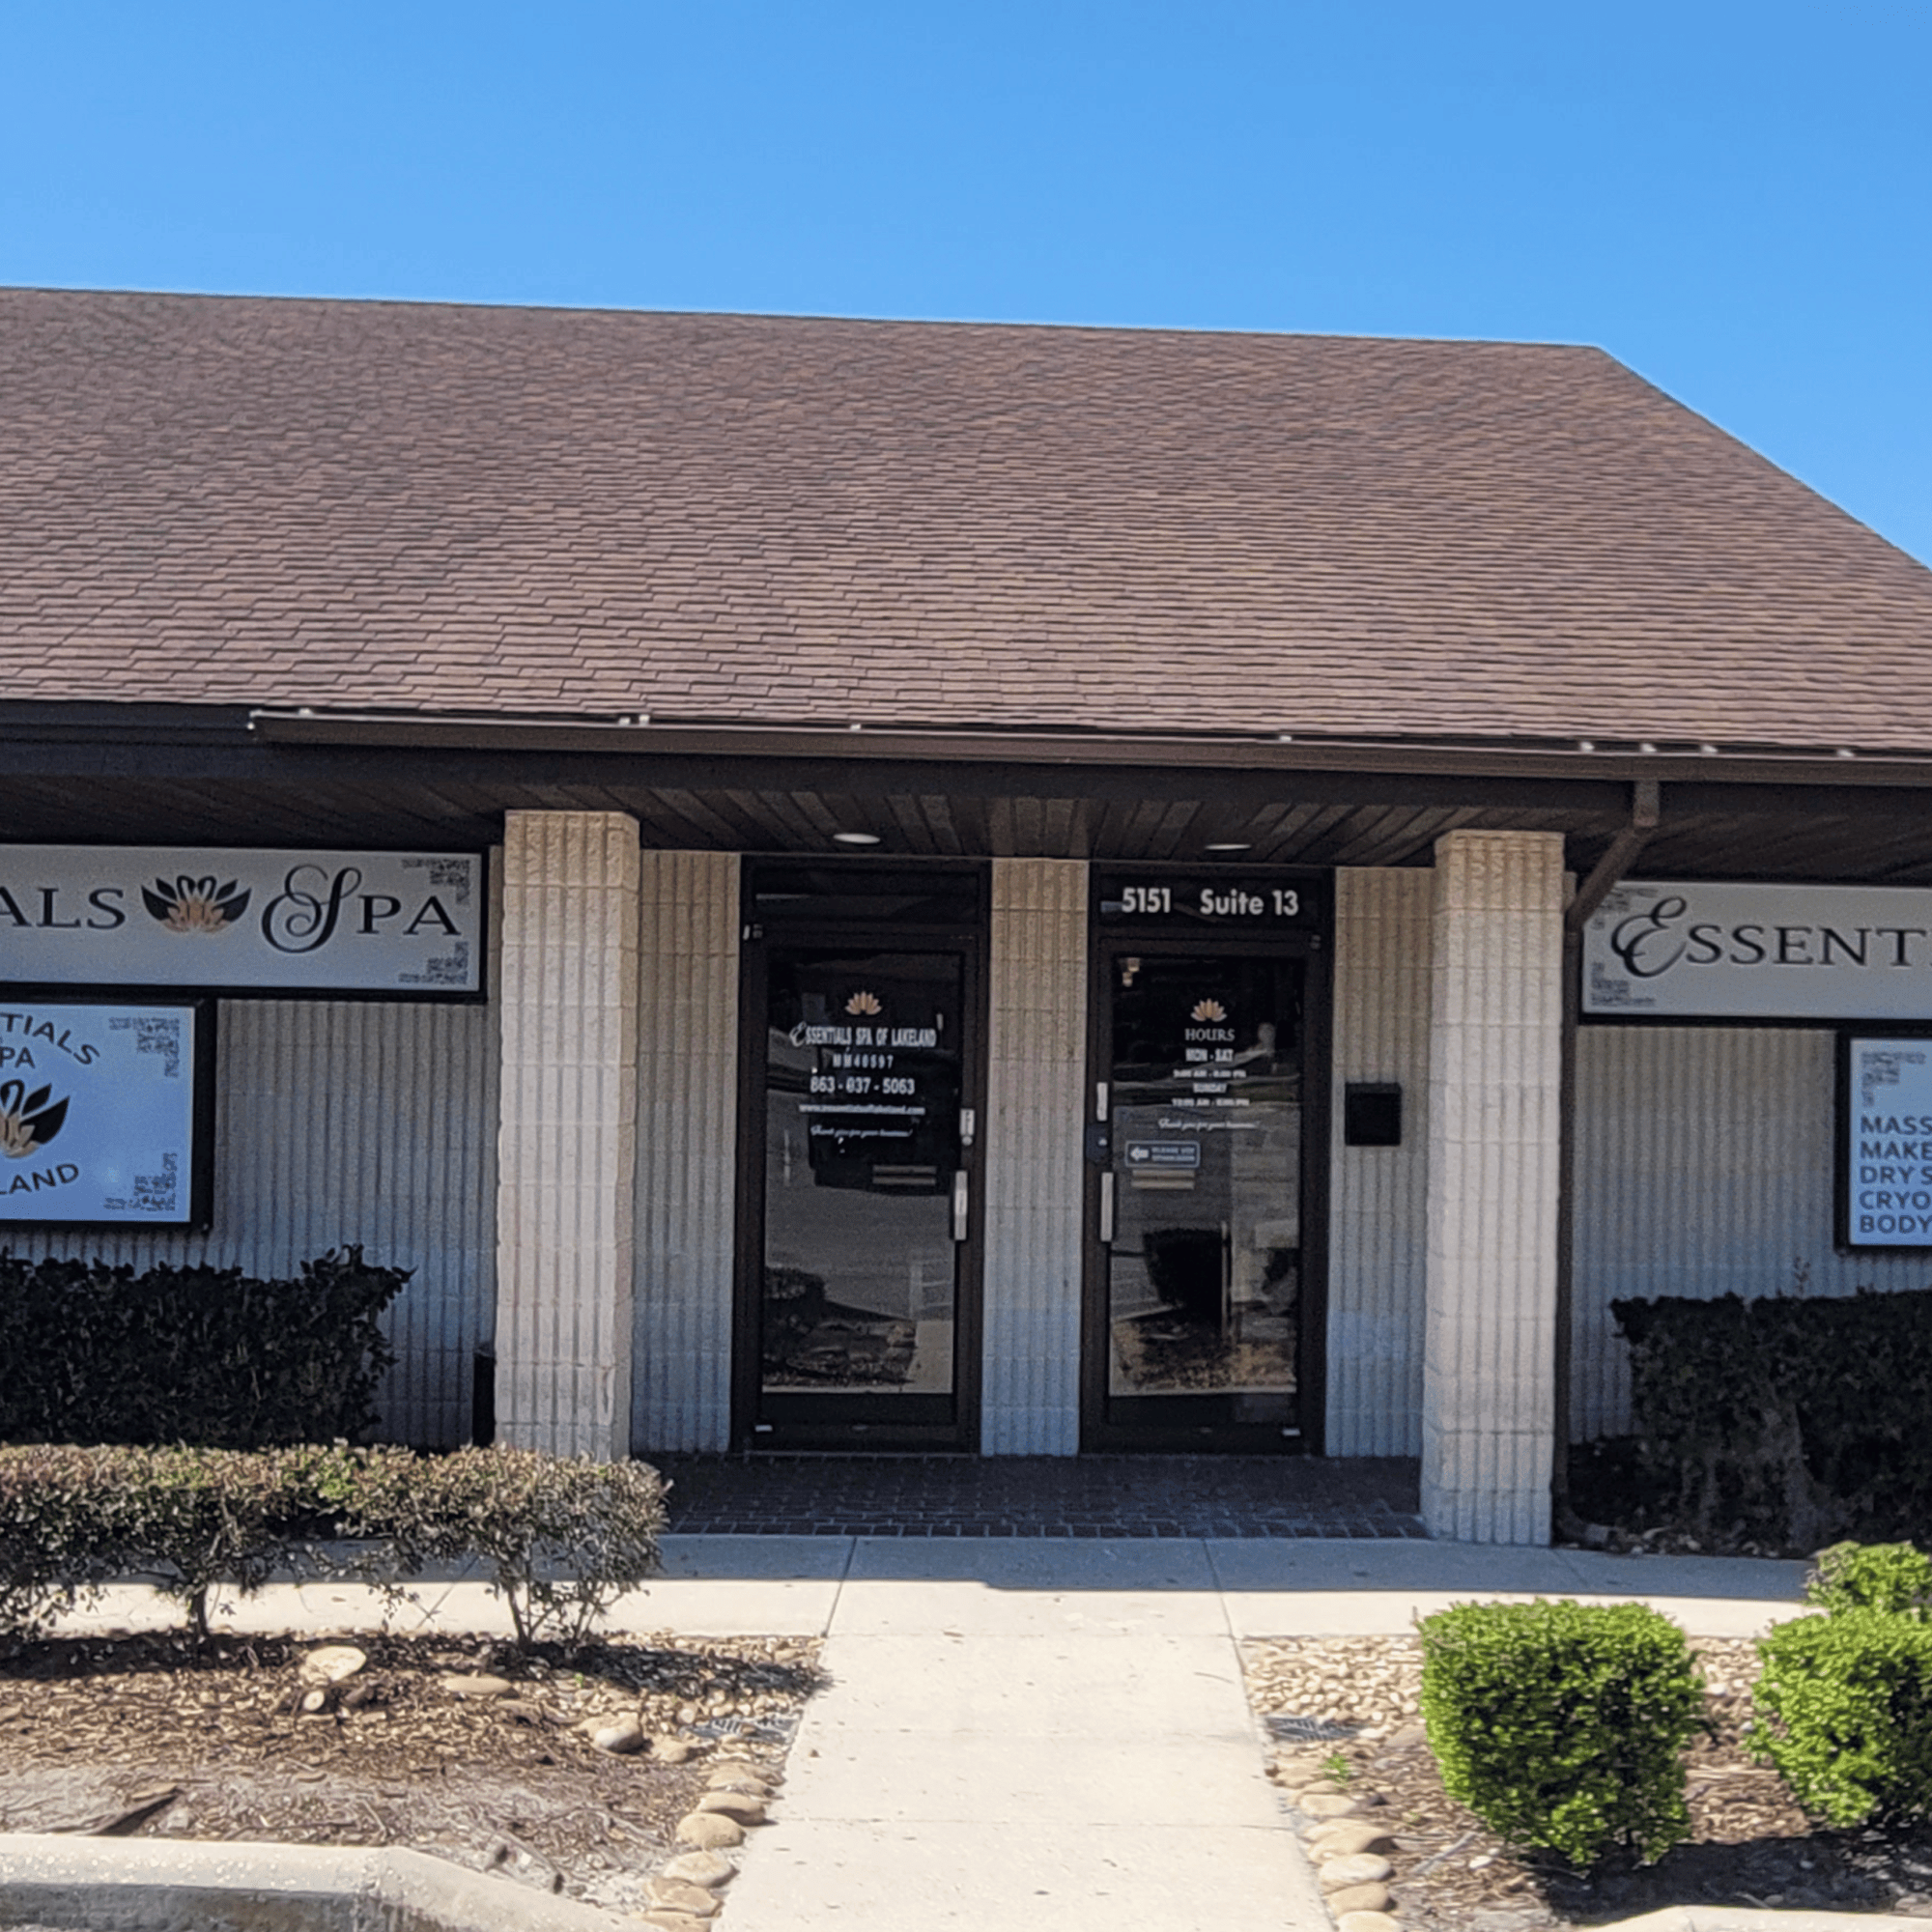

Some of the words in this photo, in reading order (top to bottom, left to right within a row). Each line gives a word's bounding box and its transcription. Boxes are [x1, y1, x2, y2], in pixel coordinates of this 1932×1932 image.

[261, 863, 461, 953] SPA
[1122, 886, 1171, 913] 5151
[1200, 888, 1264, 915] Suite
[1271, 889, 1299, 916] 13
[855, 1026, 872, 1046] SPA
[876, 1027, 889, 1047] OF
[891, 1027, 937, 1048] LAKELAND
[1184, 1028, 1236, 1042] HOURS
[1861, 1115, 1932, 1136] MASS
[1861, 1140, 1932, 1160] MAKE
[1860, 1165, 1915, 1184] DRY
[1859, 1190, 1931, 1210] CRYO
[1860, 1214, 1932, 1234] BODY
